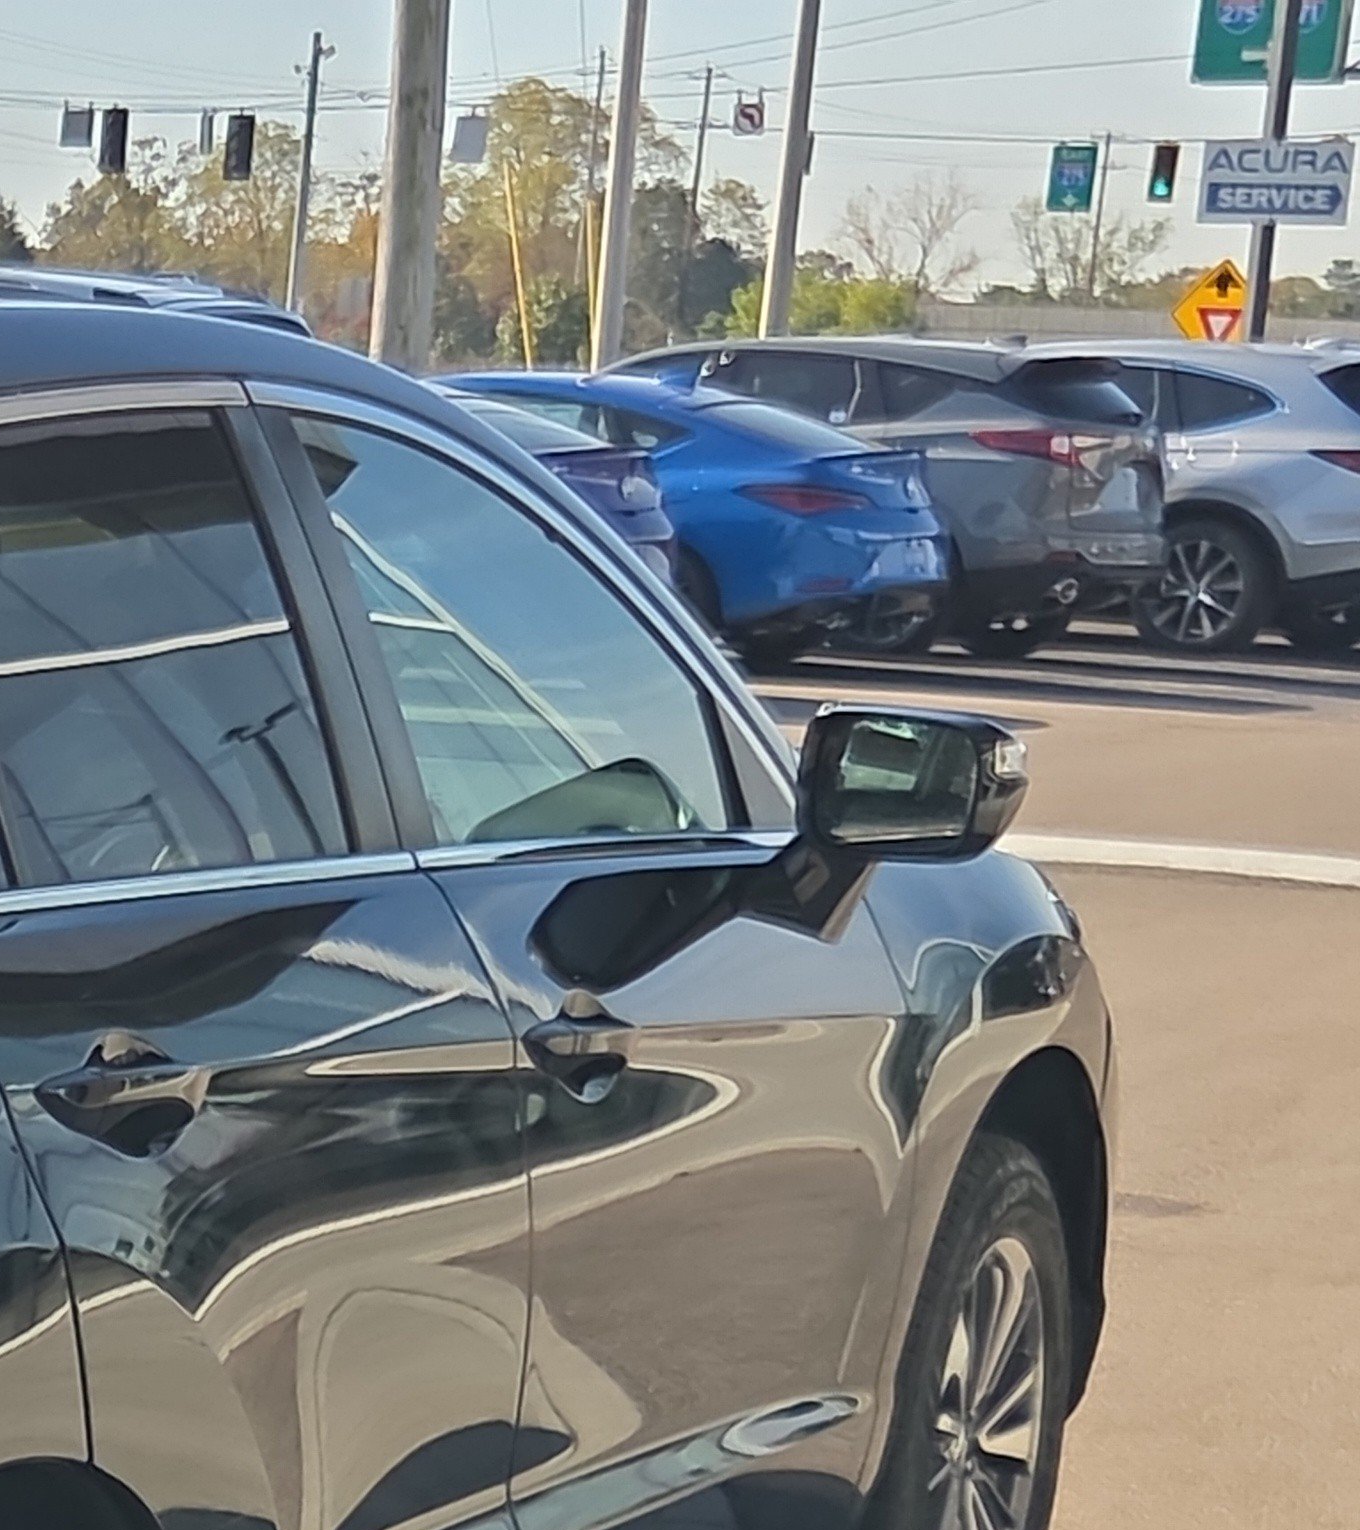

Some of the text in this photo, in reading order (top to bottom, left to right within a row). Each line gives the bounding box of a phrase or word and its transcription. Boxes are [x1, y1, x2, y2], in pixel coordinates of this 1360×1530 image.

[1219, 4, 1256, 23] 275
[1207, 147, 1349, 174] ACURA
[1216, 186, 1333, 210] SERVICE
